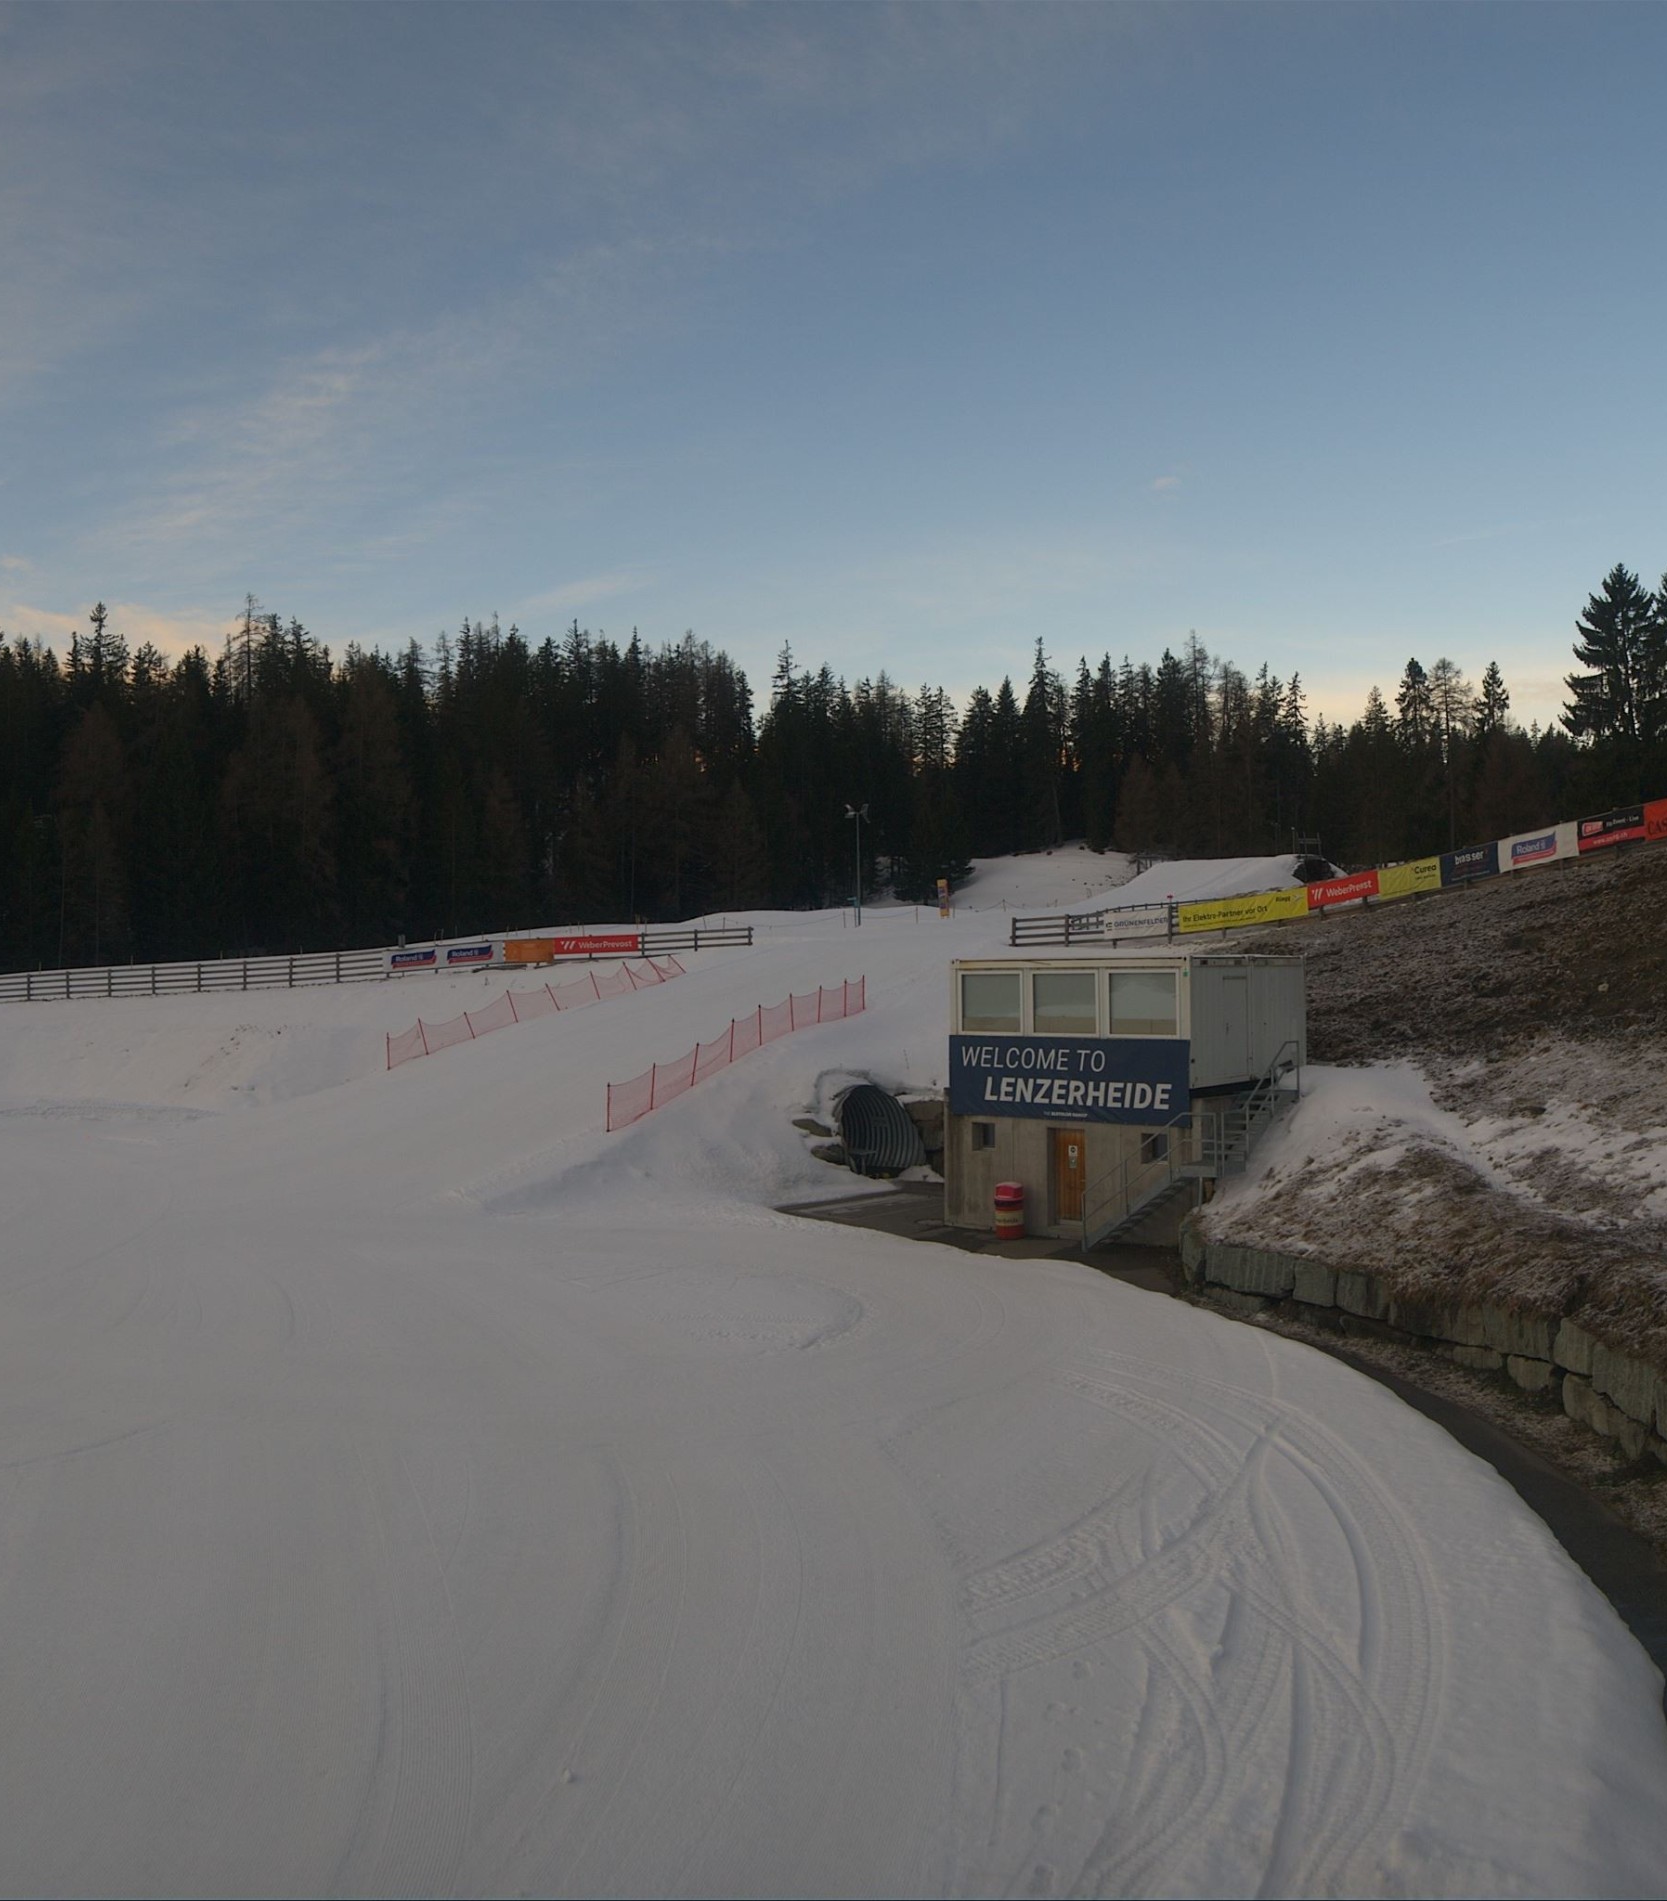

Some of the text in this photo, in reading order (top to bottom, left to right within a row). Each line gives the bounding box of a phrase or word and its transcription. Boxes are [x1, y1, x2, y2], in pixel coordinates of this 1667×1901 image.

[1515, 841, 1541, 855] Roland
[1256, 904, 1269, 914] Ort
[961, 1045, 1106, 1073] WELCOME TO
[984, 1076, 1172, 1111] LENZERHEIDE
